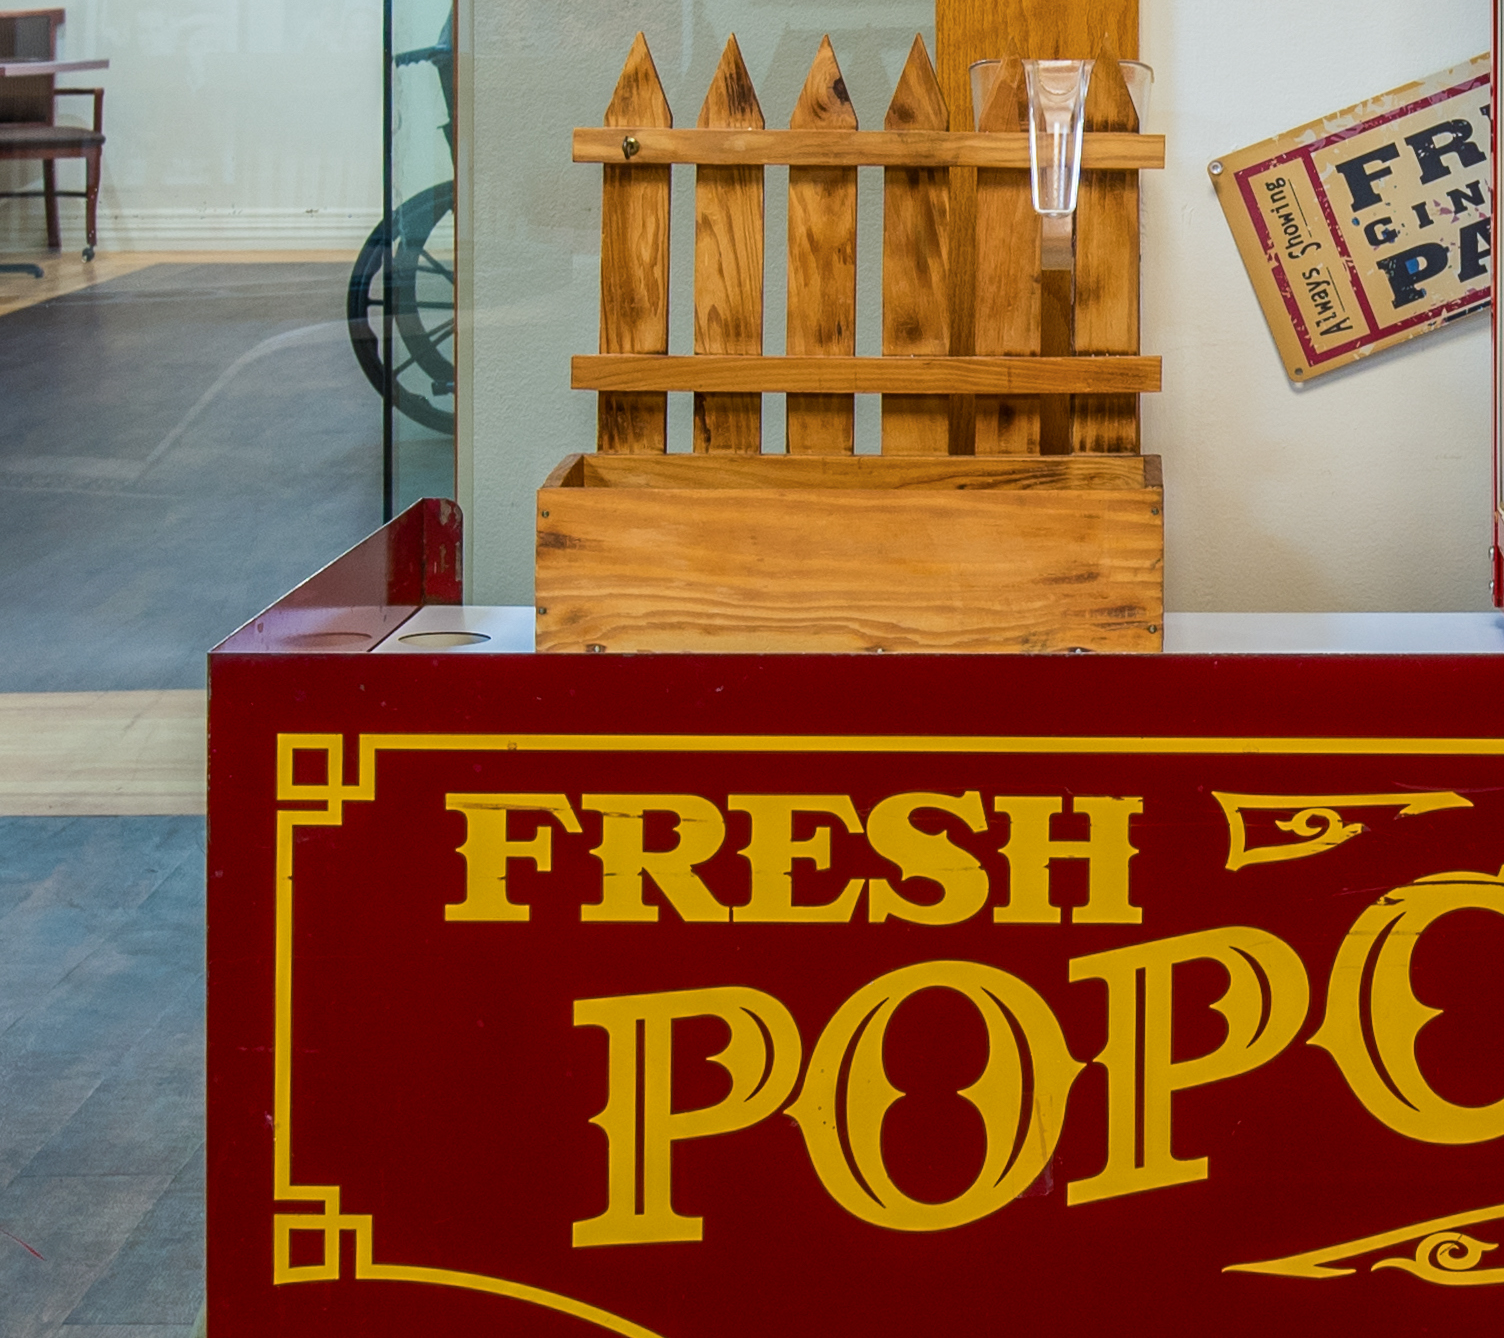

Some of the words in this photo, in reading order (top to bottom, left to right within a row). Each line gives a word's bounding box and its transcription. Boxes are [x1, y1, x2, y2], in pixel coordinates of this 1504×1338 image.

[1265, 175, 1323, 261] Showing
[1302, 267, 1354, 337] Always
[444, 790, 1144, 925] FRESH
